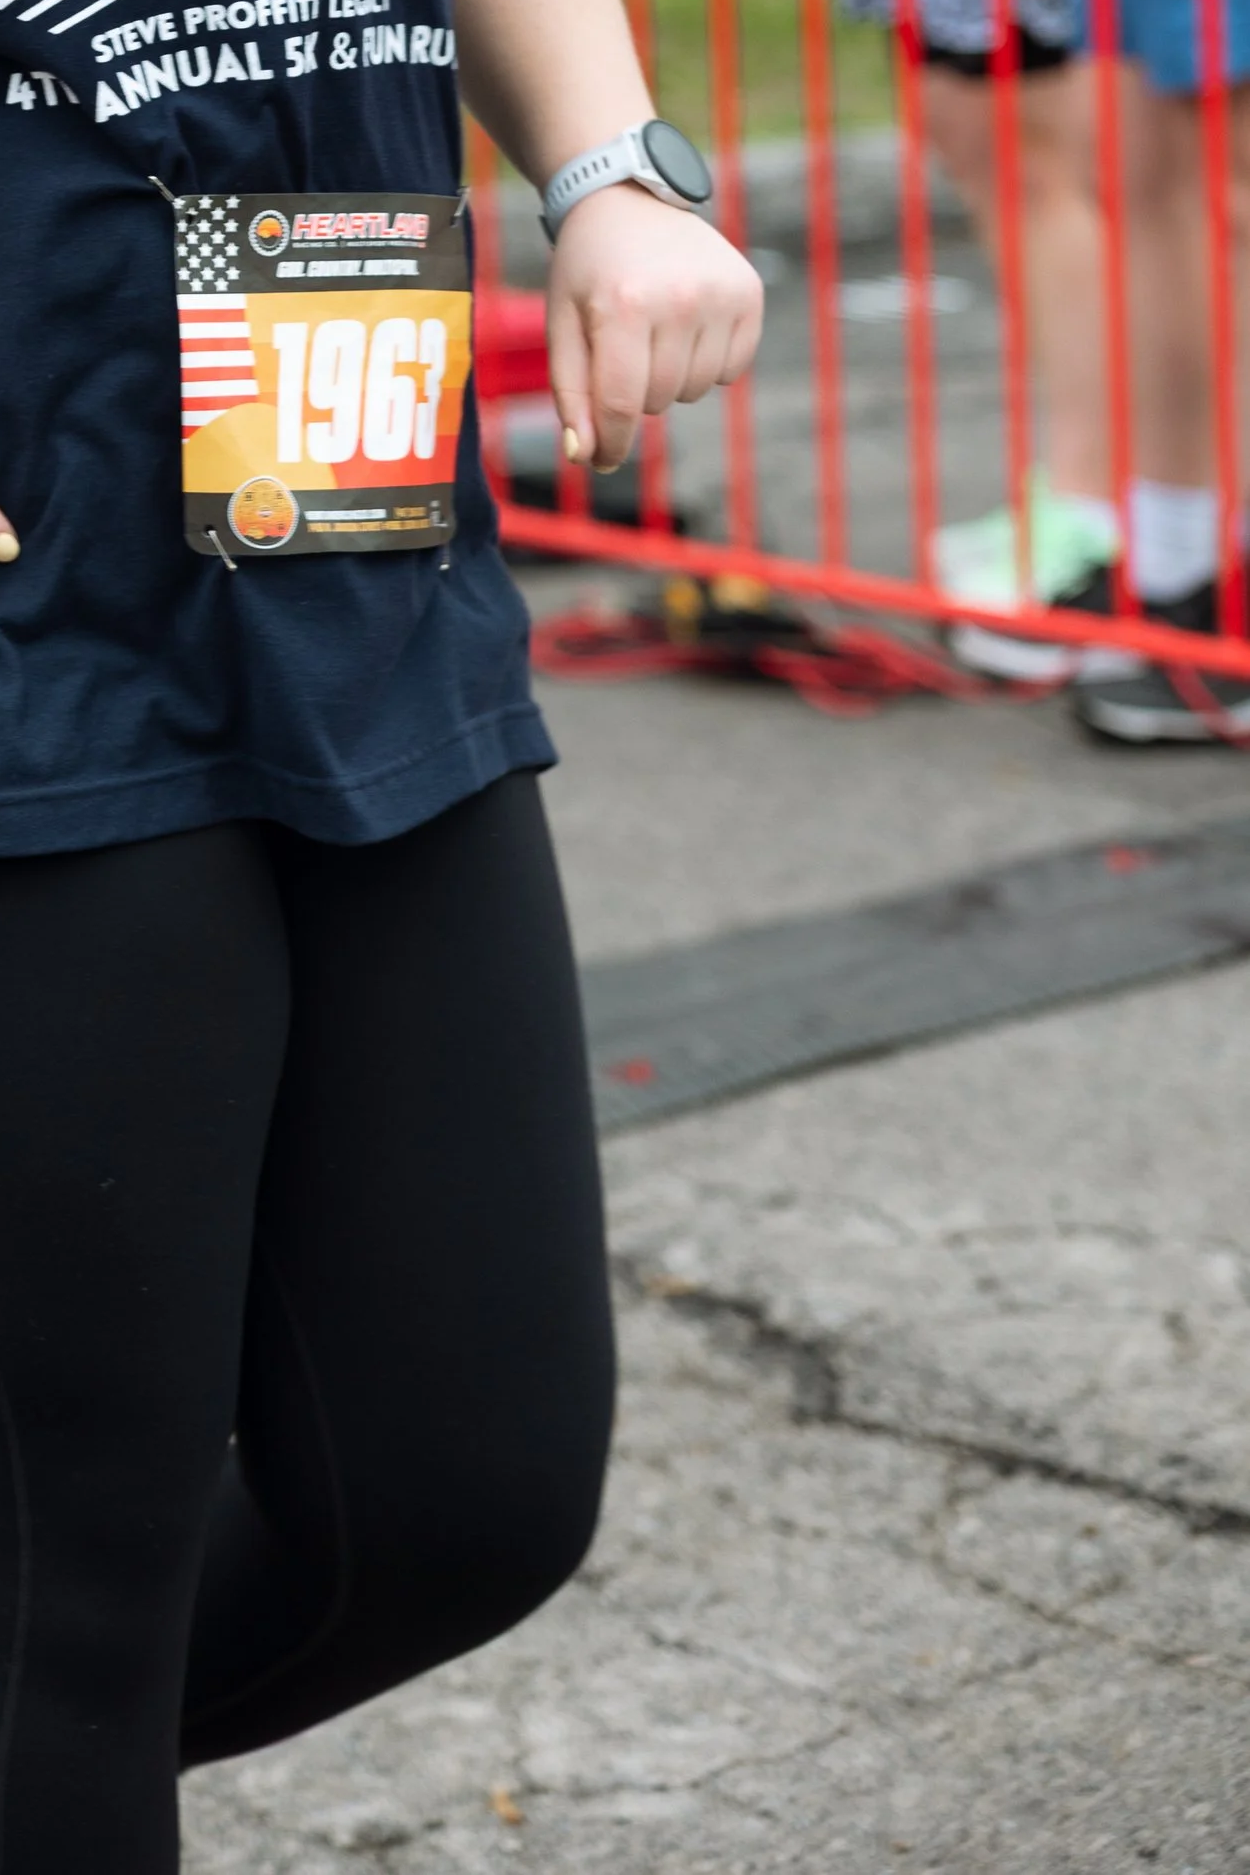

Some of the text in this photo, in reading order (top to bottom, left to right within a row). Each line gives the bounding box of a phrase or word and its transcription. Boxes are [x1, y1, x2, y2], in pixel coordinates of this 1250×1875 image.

[91, 12, 179, 63] STEVE
[95, 42, 274, 124] ANNUAL
[284, 31, 319, 78] 5K
[329, 32, 358, 70] &
[362, 23, 407, 68] FUN
[409, 25, 459, 70] RU
[272, 317, 447, 465] 1963
